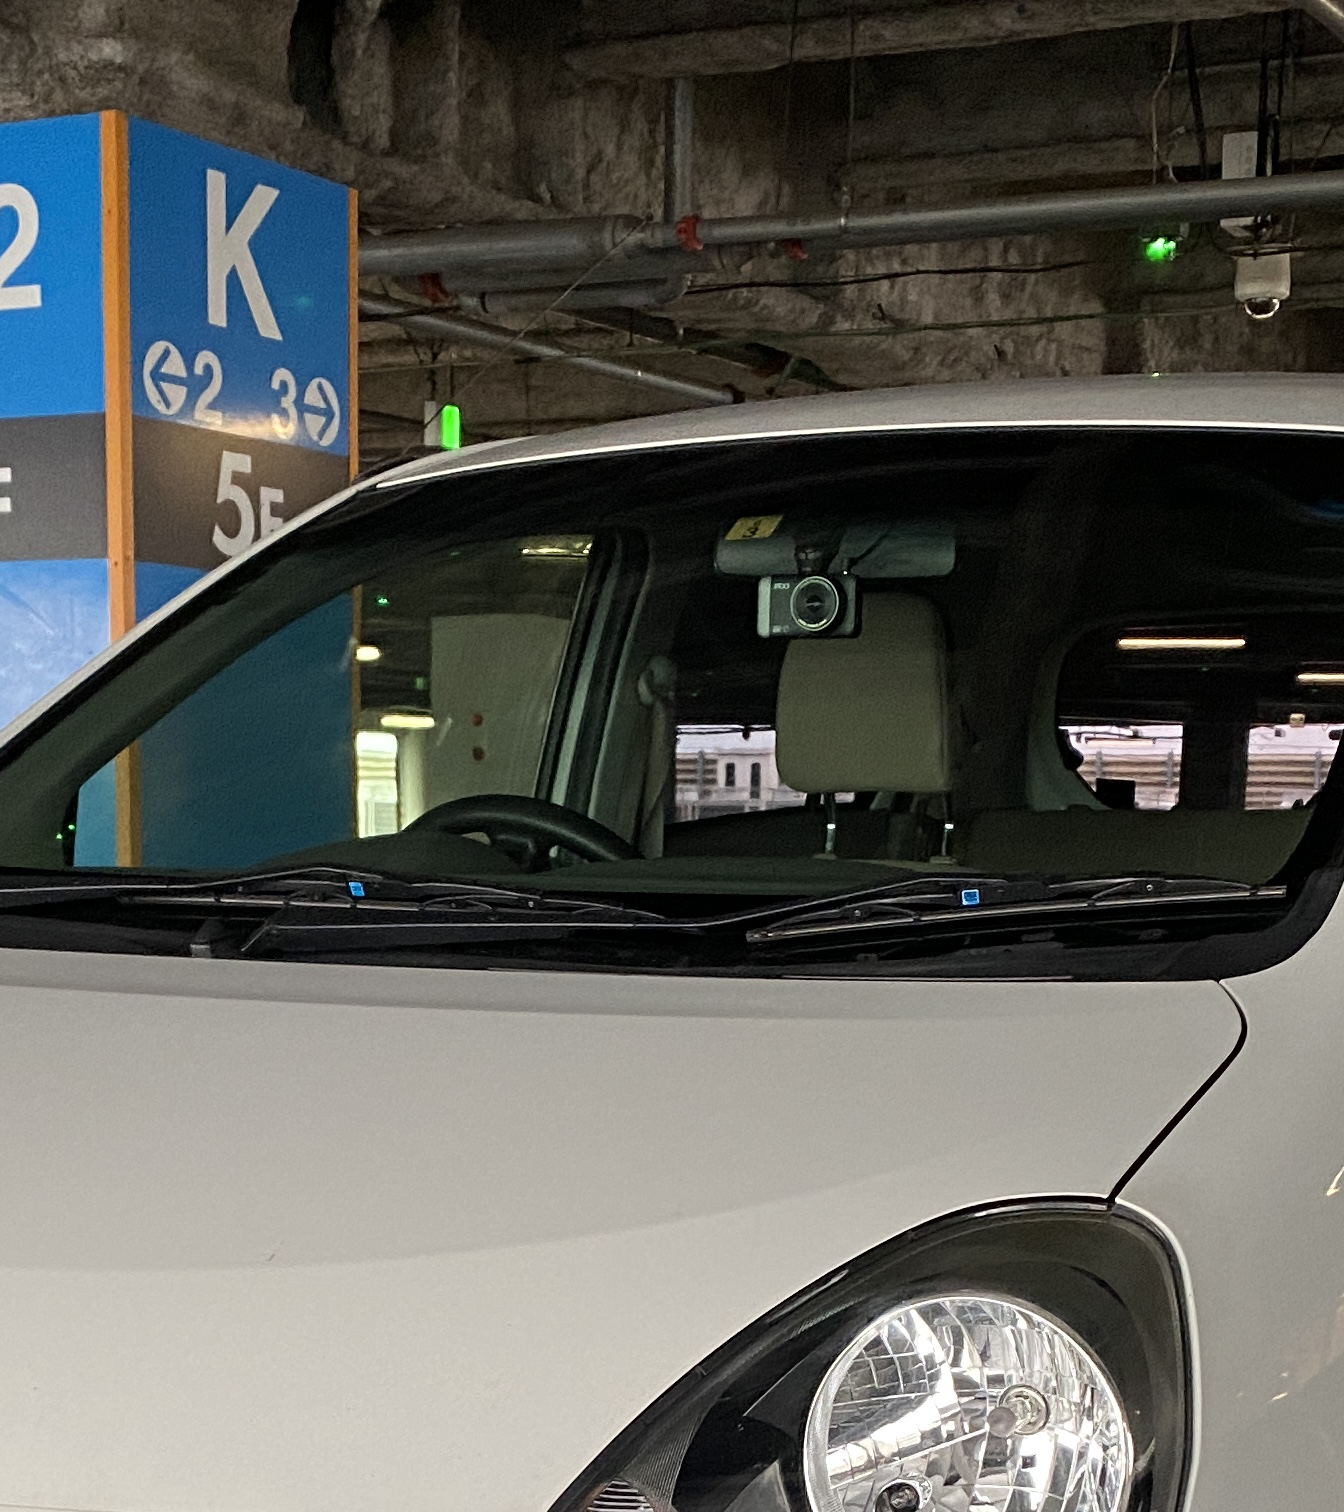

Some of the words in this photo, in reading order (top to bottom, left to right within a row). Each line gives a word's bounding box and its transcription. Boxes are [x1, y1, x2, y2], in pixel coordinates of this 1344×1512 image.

[205, 167, 284, 341] K
[193, 349, 224, 427] 2
[270, 366, 298, 440] 3
[212, 449, 285, 557] 5F
